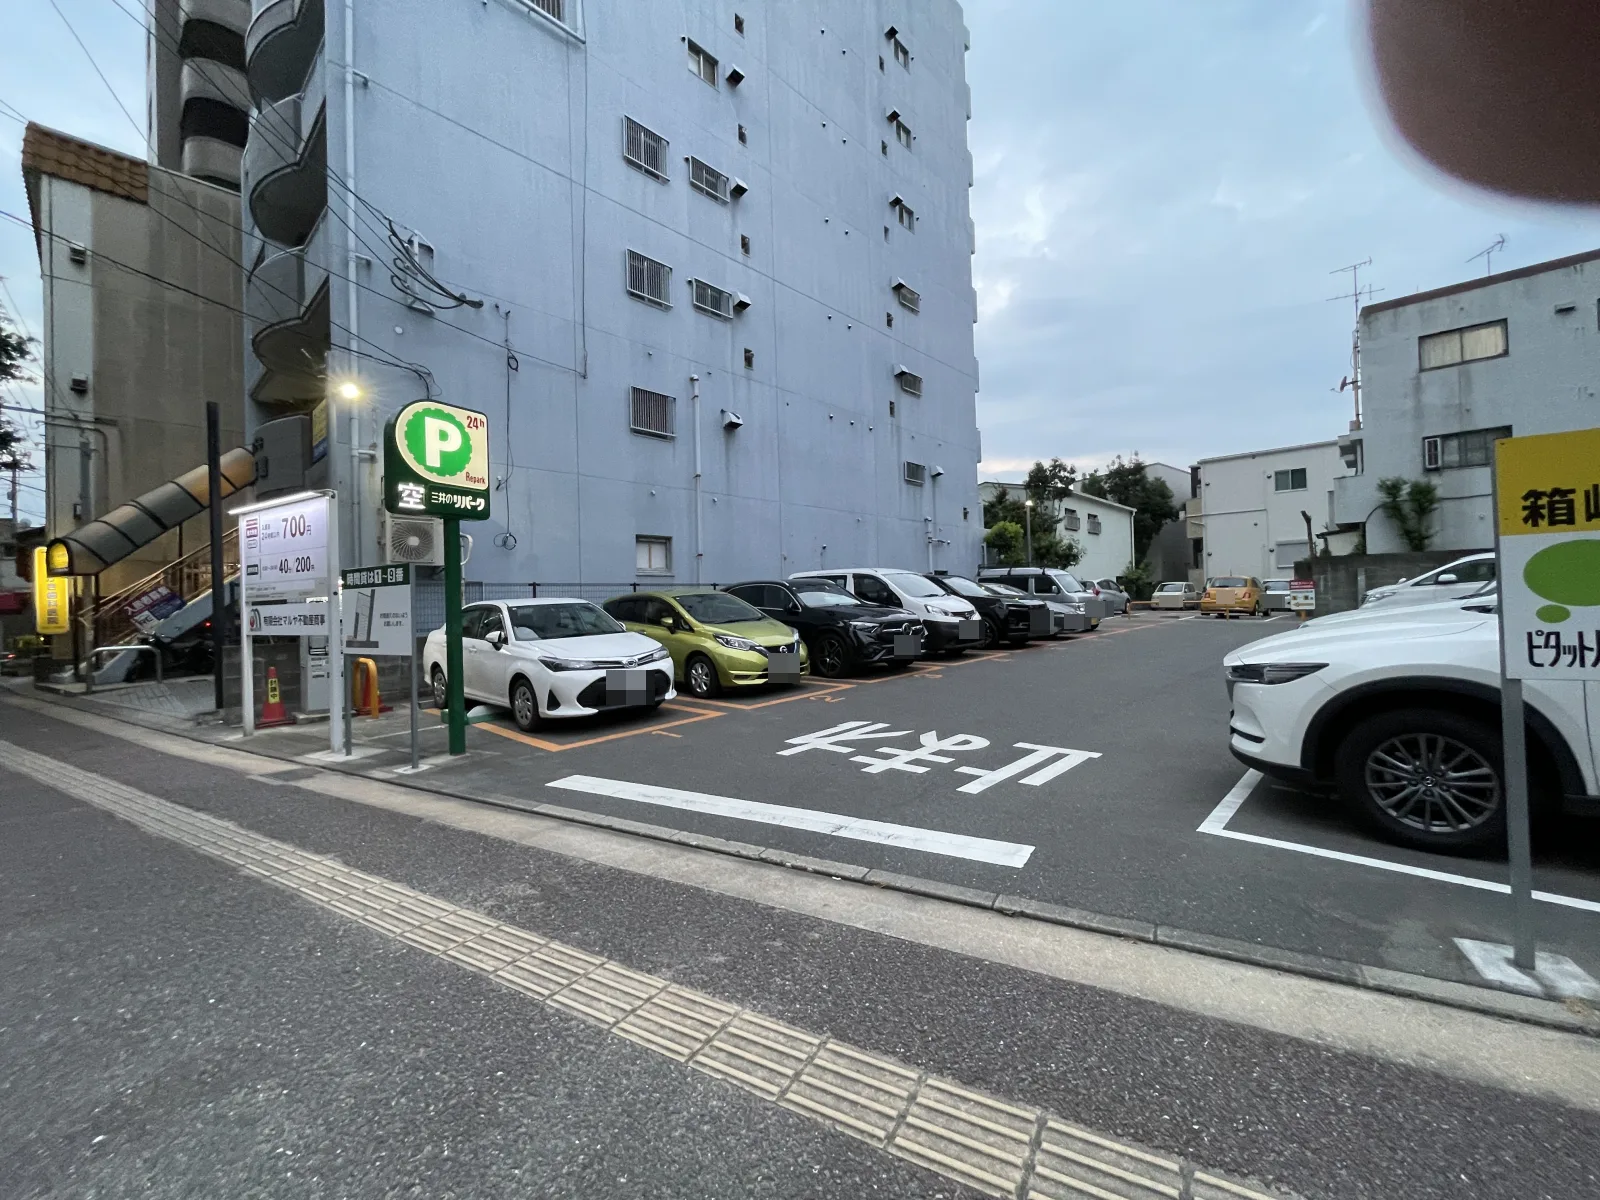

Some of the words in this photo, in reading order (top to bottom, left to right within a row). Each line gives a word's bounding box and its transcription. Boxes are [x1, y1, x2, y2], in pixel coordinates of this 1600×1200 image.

[424, 416, 462, 467] P
[465, 471, 486, 485] Repark
[397, 482, 426, 509] 空
